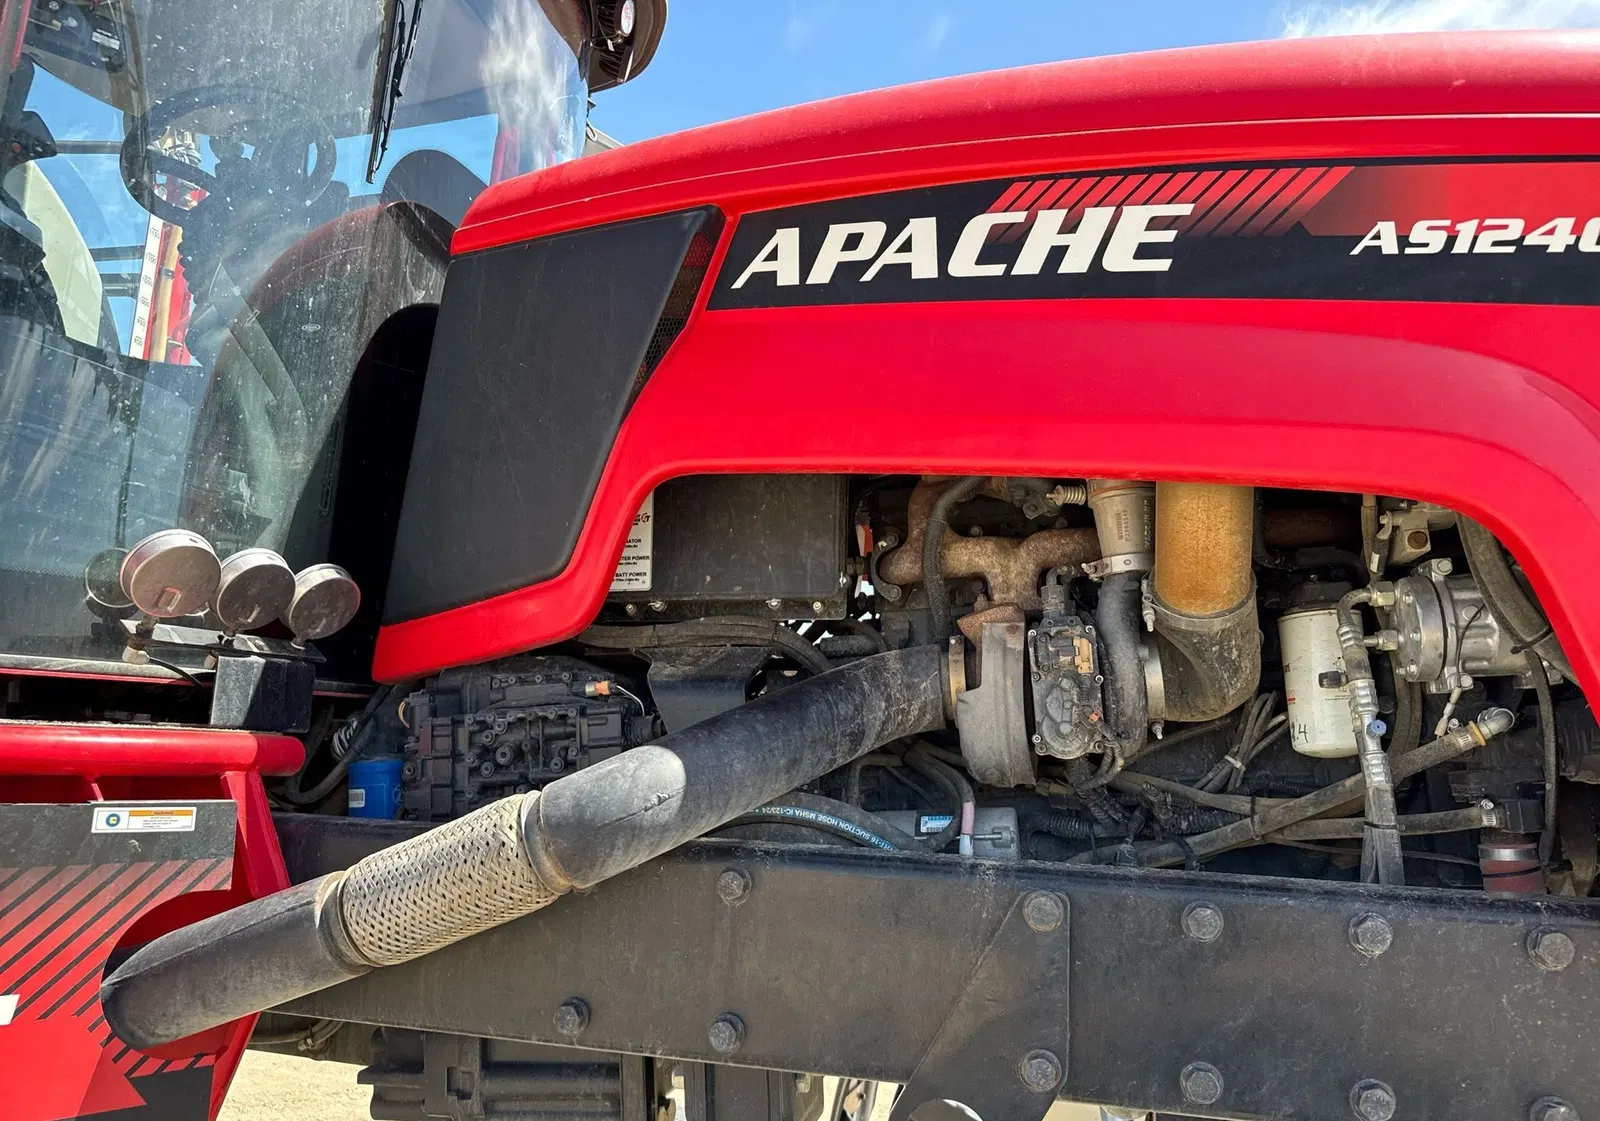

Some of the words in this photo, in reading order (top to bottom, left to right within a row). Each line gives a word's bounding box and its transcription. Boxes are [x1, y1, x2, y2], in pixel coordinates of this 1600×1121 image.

[730, 203, 1196, 289] APACHE
[795, 809, 816, 820] MSHA
[817, 814, 838, 826] HOSE
[838, 822, 871, 840] SUCTION
